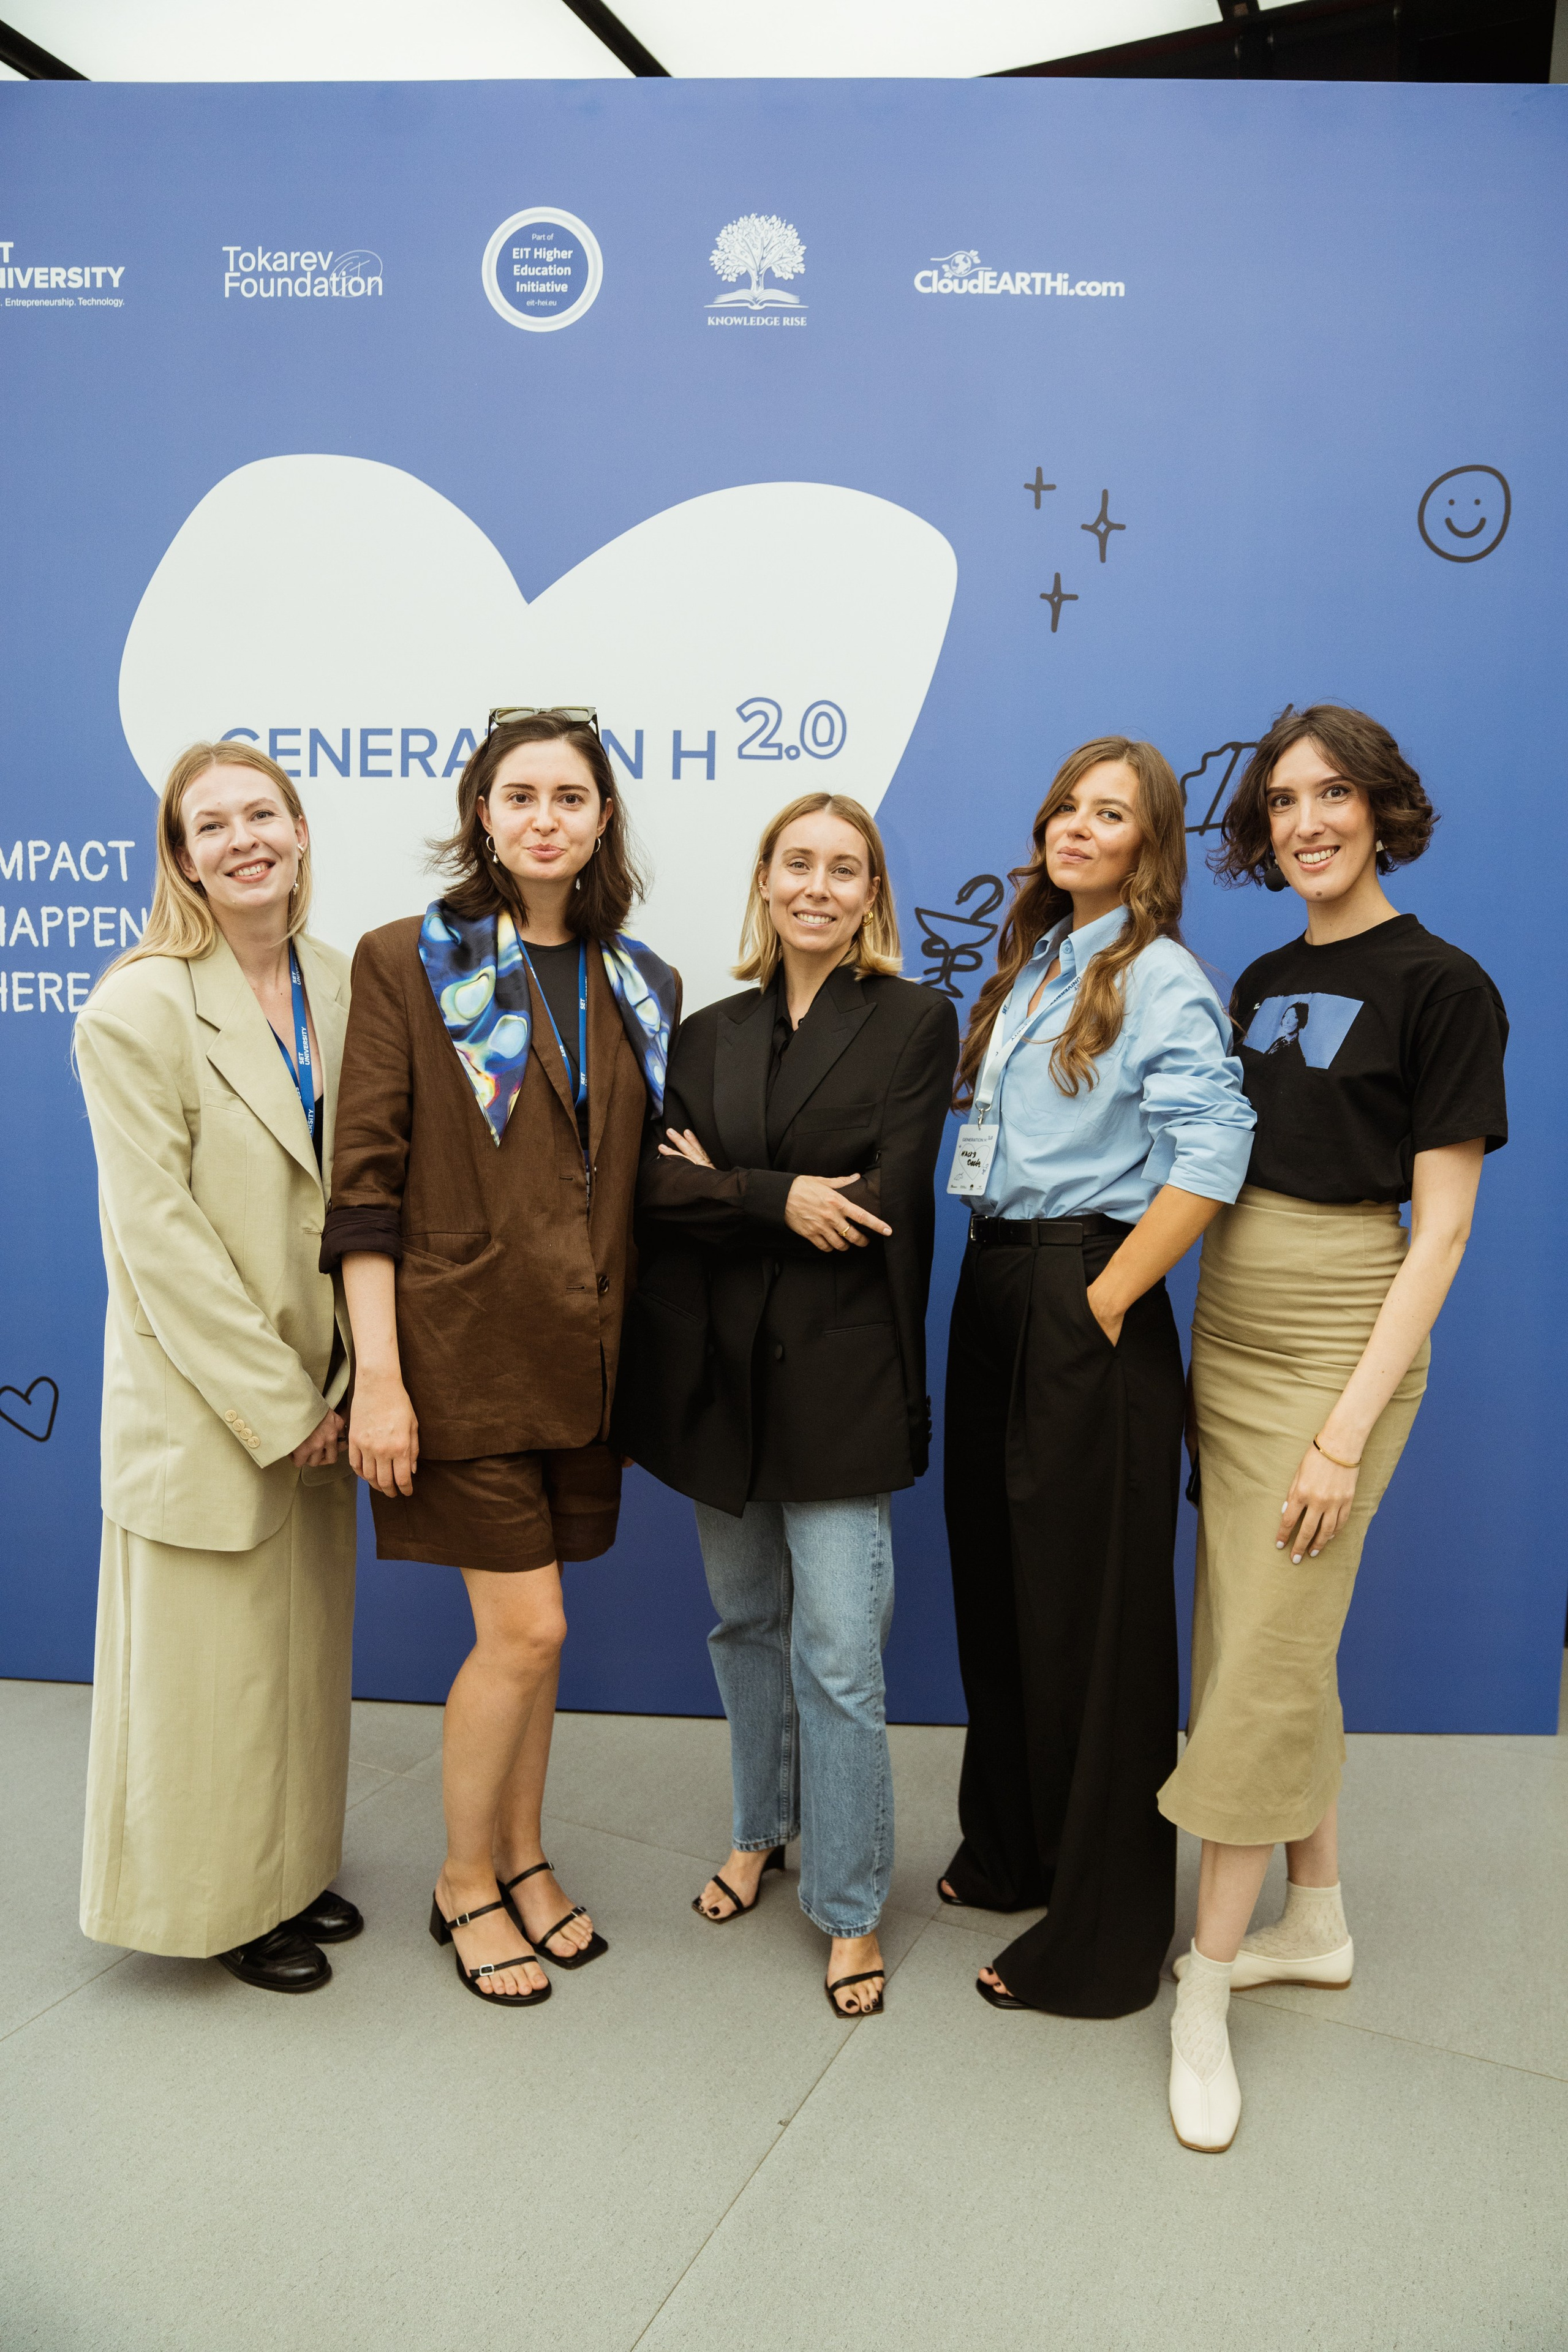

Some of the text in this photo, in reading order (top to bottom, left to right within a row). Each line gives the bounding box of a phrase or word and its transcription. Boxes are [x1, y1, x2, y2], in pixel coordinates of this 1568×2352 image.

[222, 246, 333, 272] Tokarev
[513, 247, 573, 262] EIT Higher
[513, 265, 572, 276] Education
[224, 271, 383, 298] Foundation
[516, 281, 569, 293] Initiative
[914, 271, 1125, 297] CloudEARTHi.com
[5, 298, 77, 308] Entrepreneurship.
[78, 298, 125, 308] Technology.
[707, 316, 807, 327] KNOWLEDGE RISE
[221, 697, 847, 781] ENERAN H 2.0
[301, 1026, 310, 1066] UNIVERSITY
